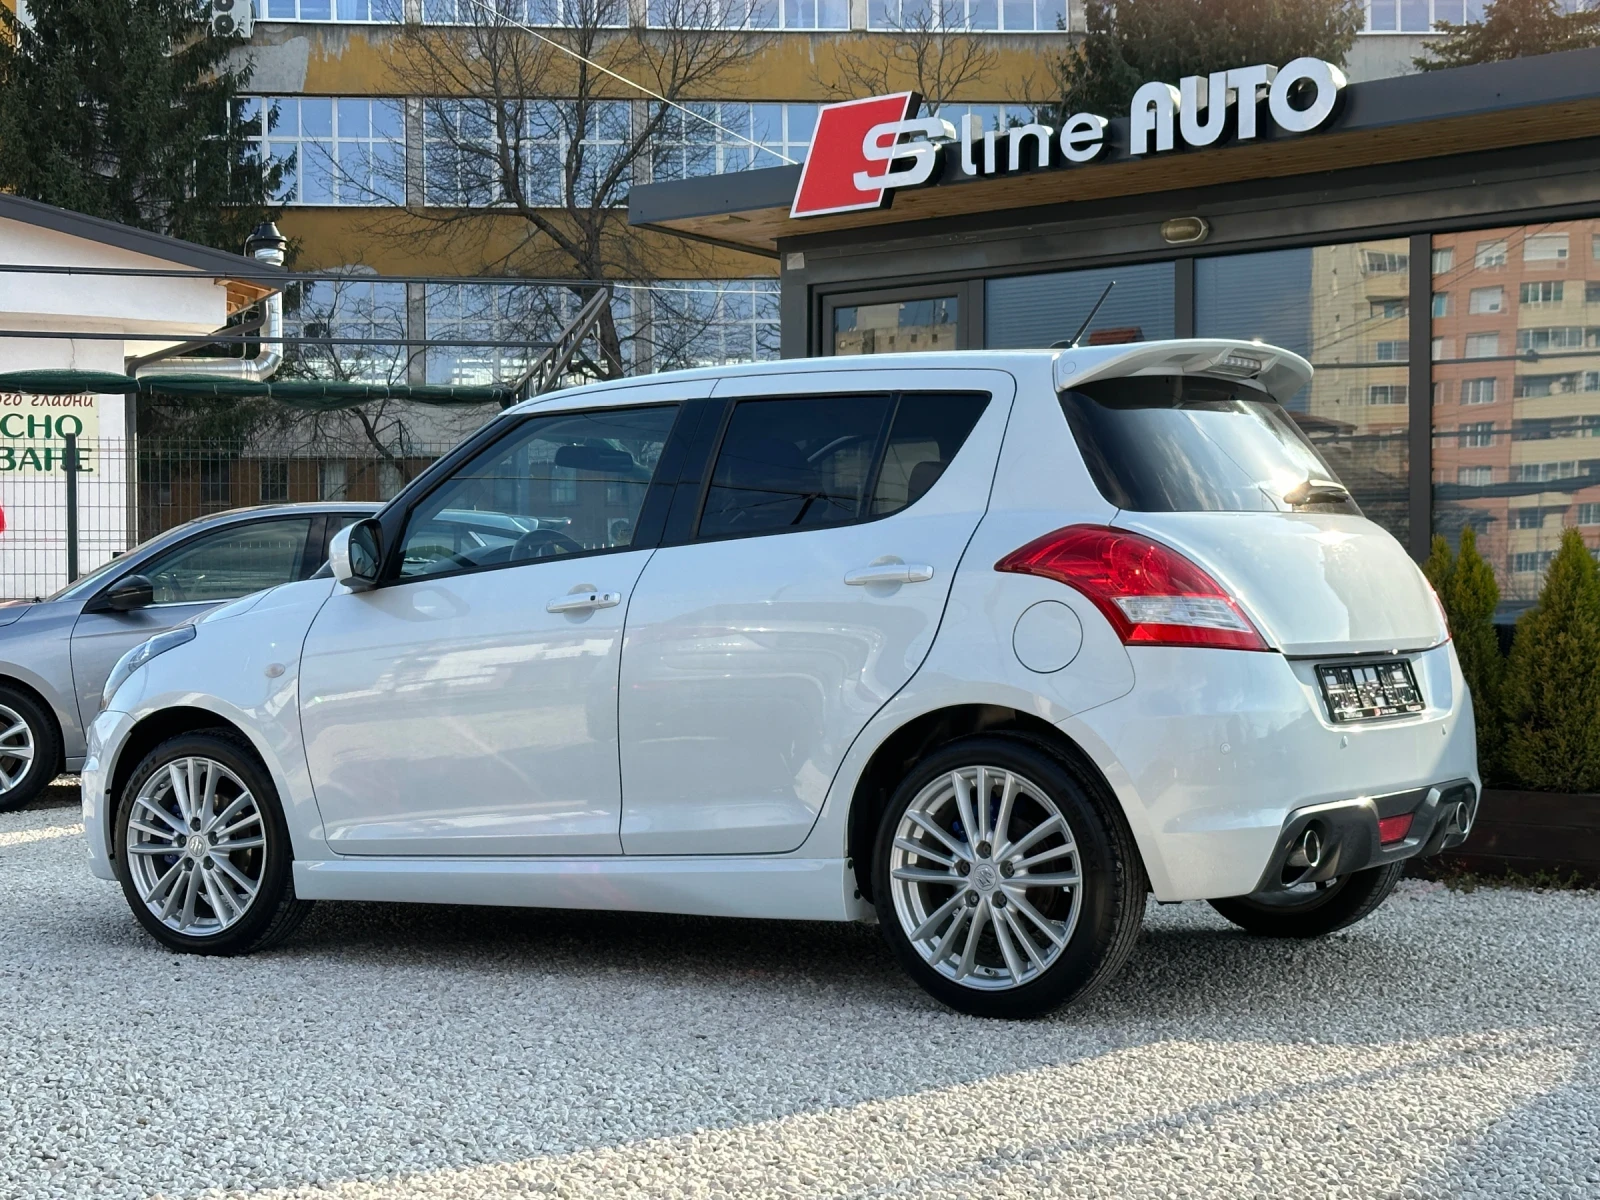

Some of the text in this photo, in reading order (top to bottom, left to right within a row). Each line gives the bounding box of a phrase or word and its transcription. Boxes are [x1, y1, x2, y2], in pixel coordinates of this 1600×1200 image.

[961, 112, 1106, 177] line
[1130, 57, 1341, 155] AUTO
[0, 393, 22, 406] го
